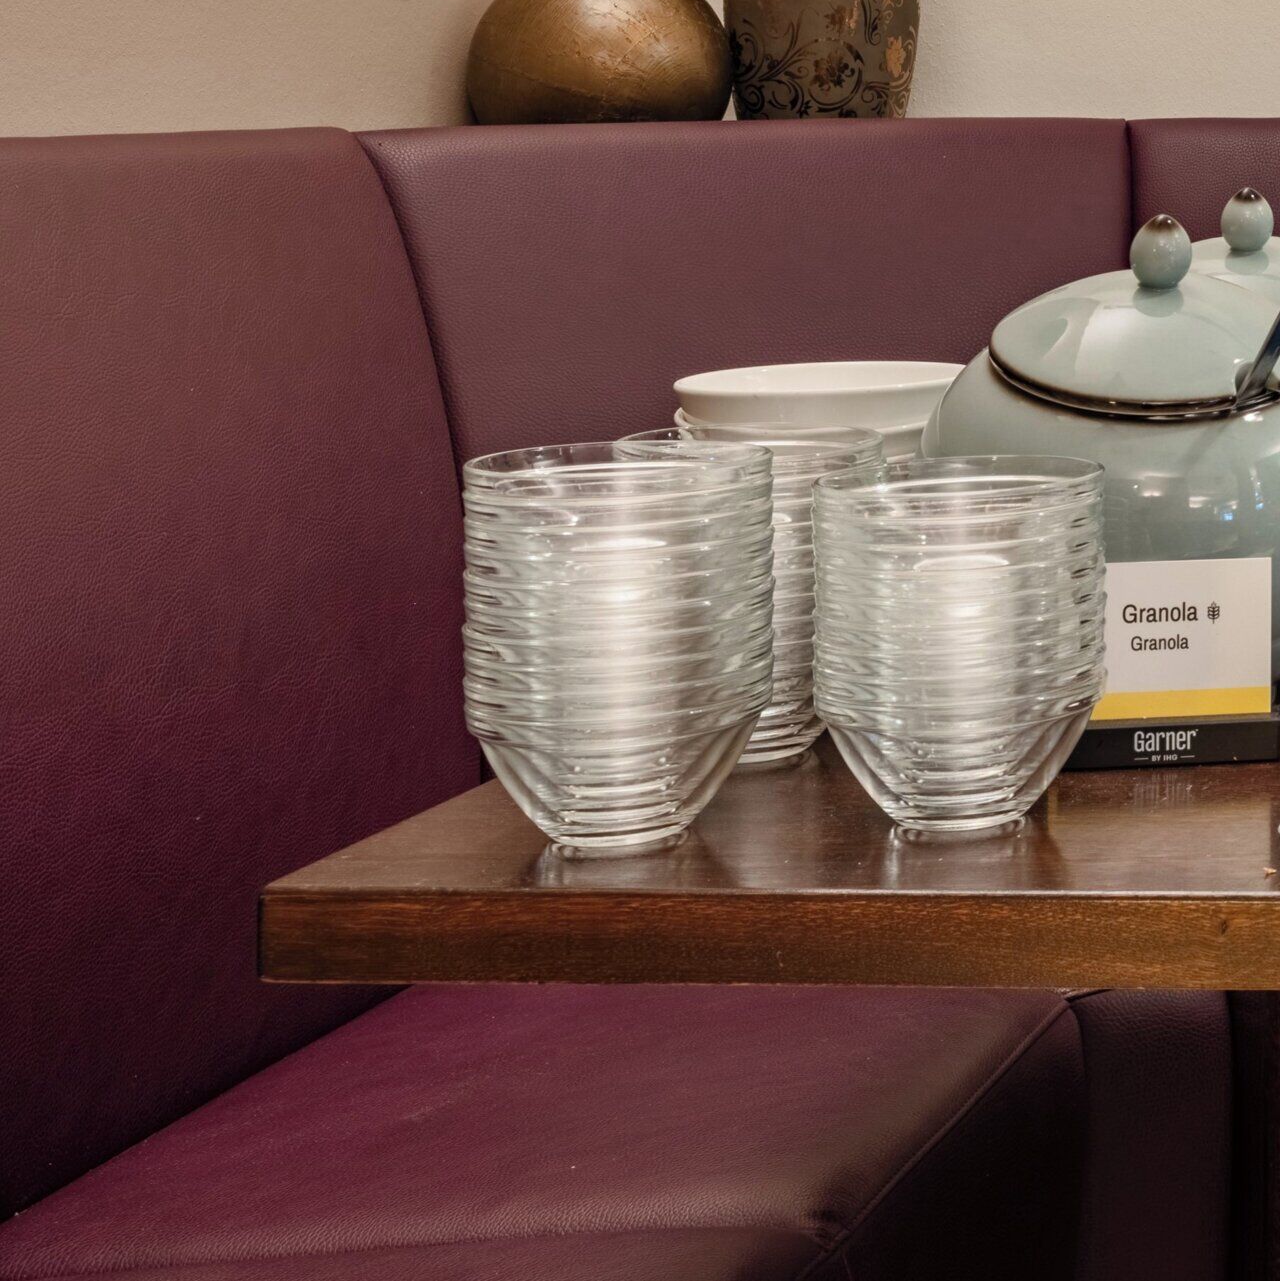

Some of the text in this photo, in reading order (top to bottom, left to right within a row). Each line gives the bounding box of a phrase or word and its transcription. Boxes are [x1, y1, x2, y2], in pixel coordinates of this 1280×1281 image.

[1122, 601, 1199, 624] Granola
[1130, 634, 1189, 651] Granola
[1134, 729, 1198, 752] Garner
[1151, 753, 1178, 762] BY IHG
